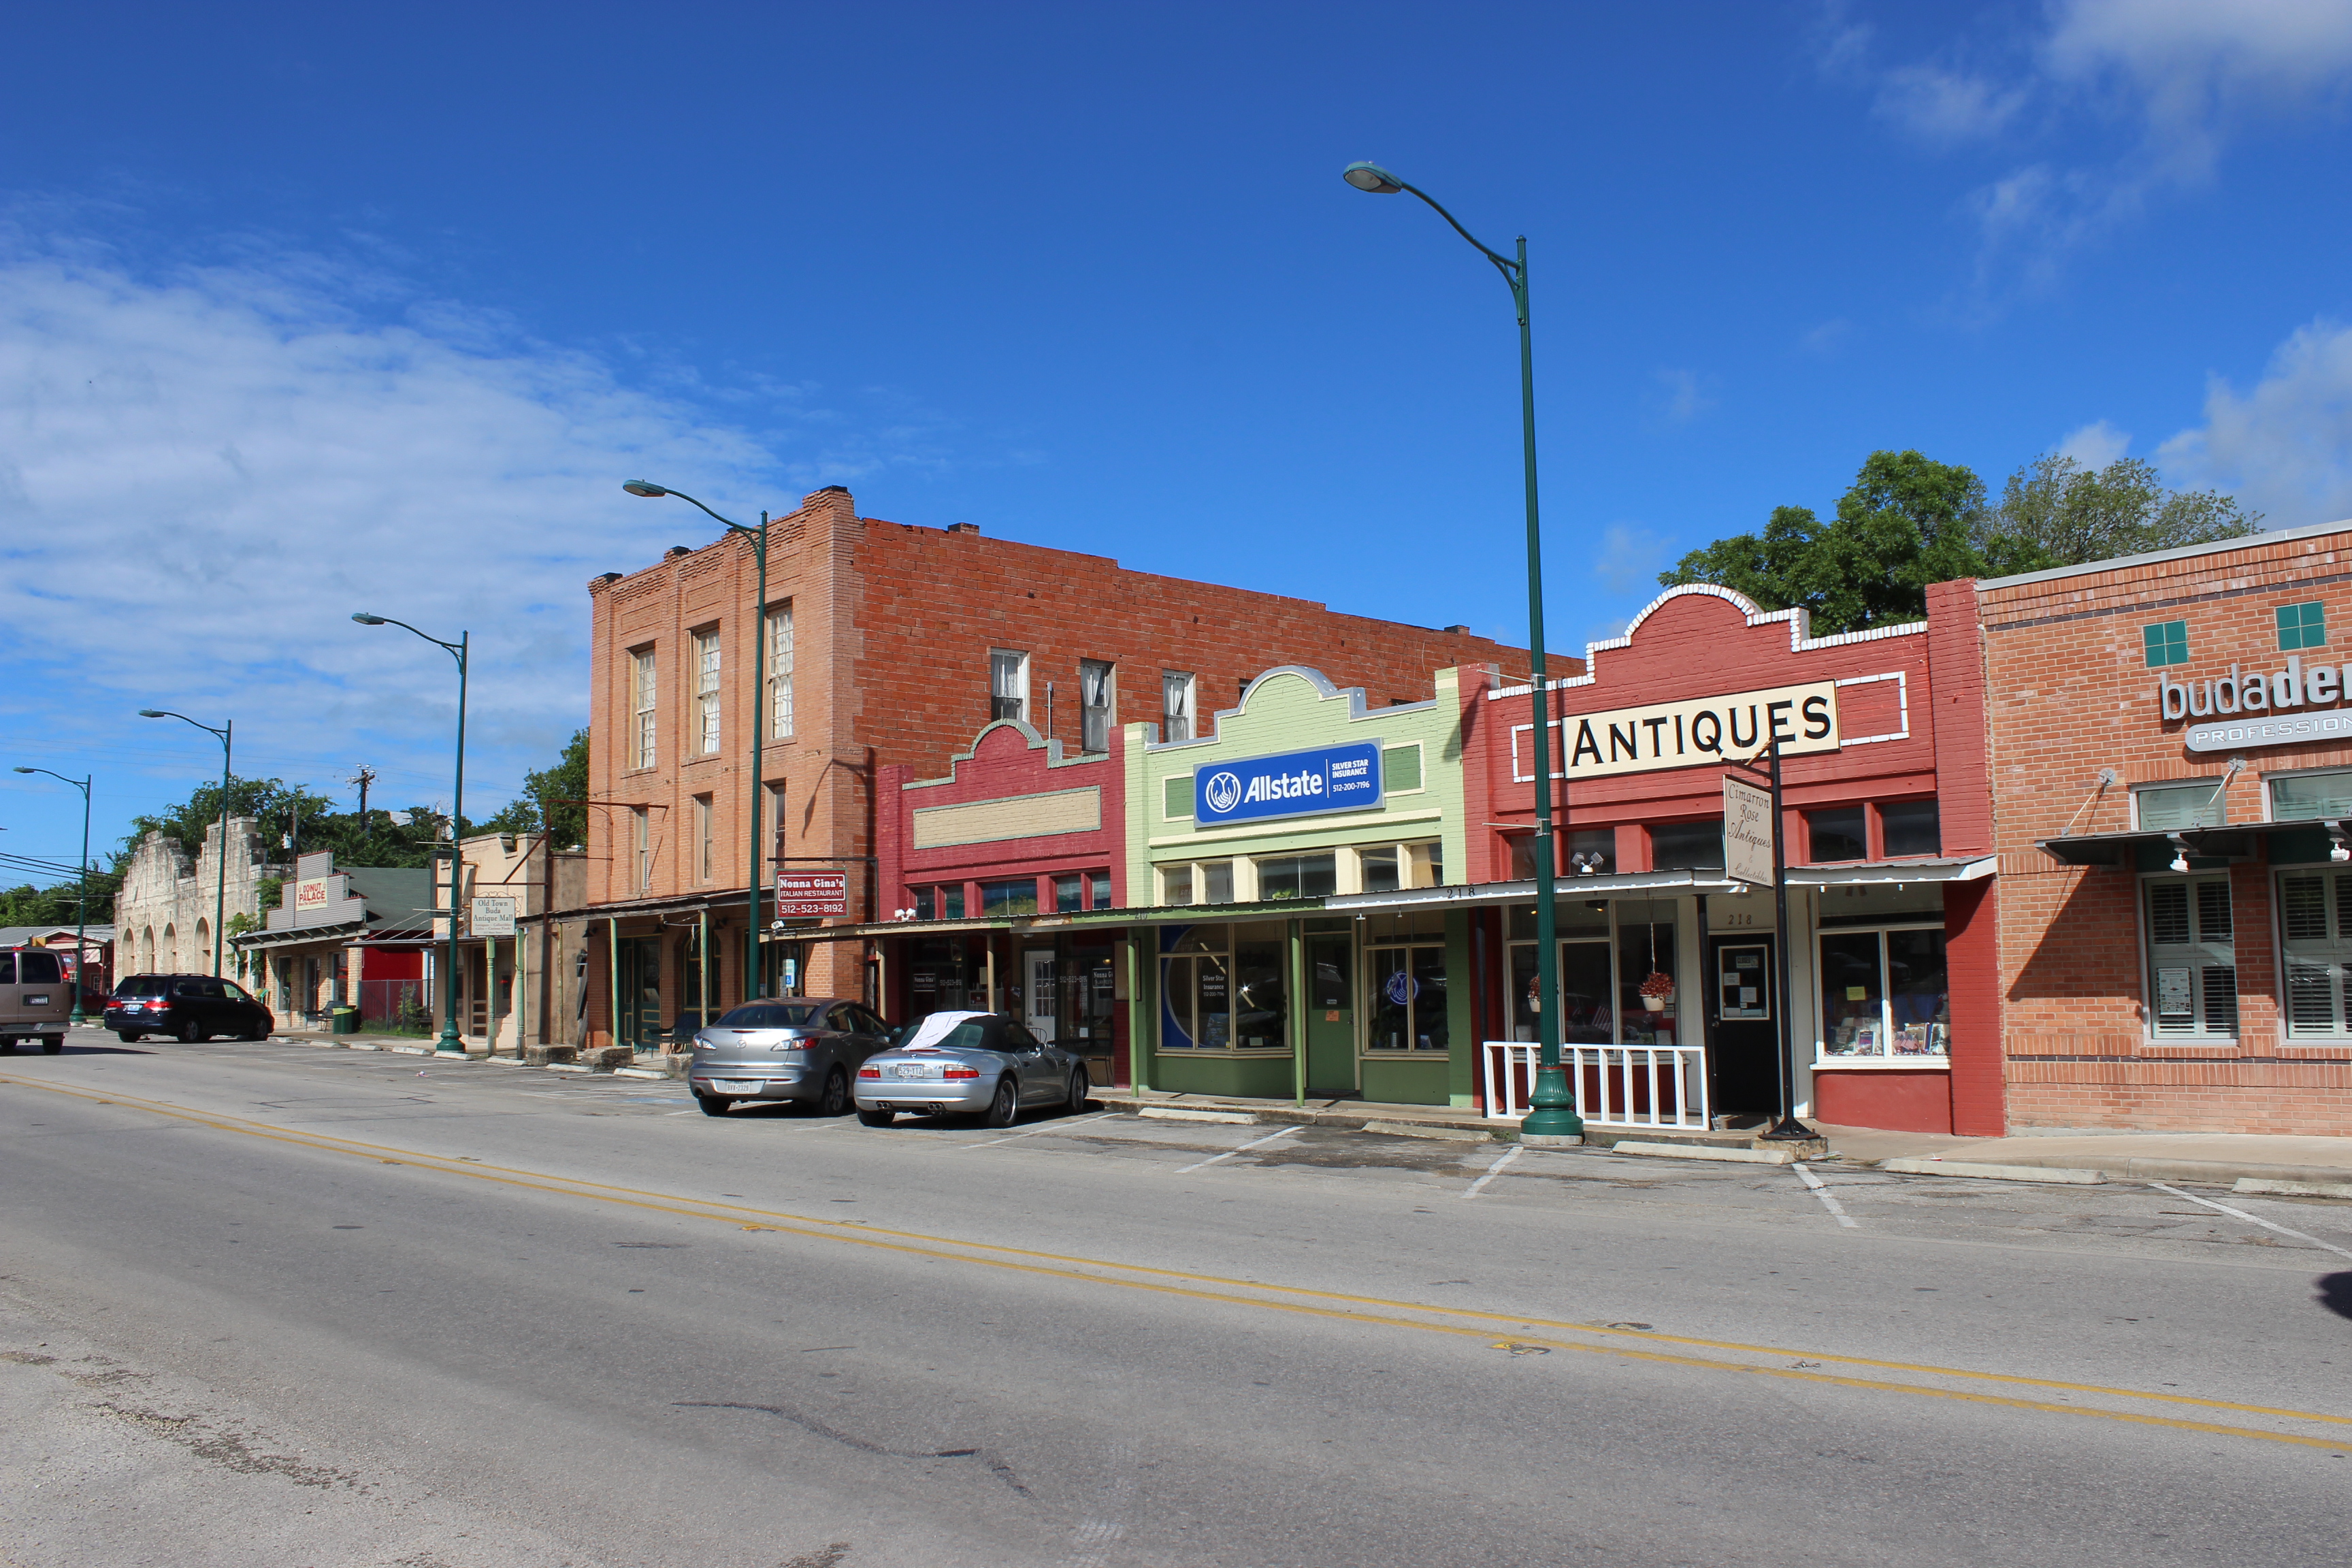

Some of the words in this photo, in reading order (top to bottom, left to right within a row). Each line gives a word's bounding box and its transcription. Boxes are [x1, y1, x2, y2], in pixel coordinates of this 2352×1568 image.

[1571, 696, 1831, 766] ANTIQUES
[1332, 761, 1352, 770] SILVER
[1352, 759, 1369, 768] STAR
[1332, 767, 1367, 779] INSURANCE
[1243, 770, 1323, 803] Allstate
[1333, 781, 1370, 792] 512-200-7196
[1729, 783, 1769, 808] Cimarron
[1740, 804, 1759, 822] Rose
[1728, 819, 1771, 851] Antiques
[1734, 863, 1767, 883] Collectibles
[303, 883, 322, 893] DONUT
[779, 879, 811, 888] Nonna
[813, 879, 844, 887] Gina's
[299, 890, 325, 902] PALACE
[1447, 887, 1475, 898] 218
[781, 904, 844, 913] 512-523-8192
[473, 915, 497, 923] Antique
[1728, 913, 1752, 926] 218
